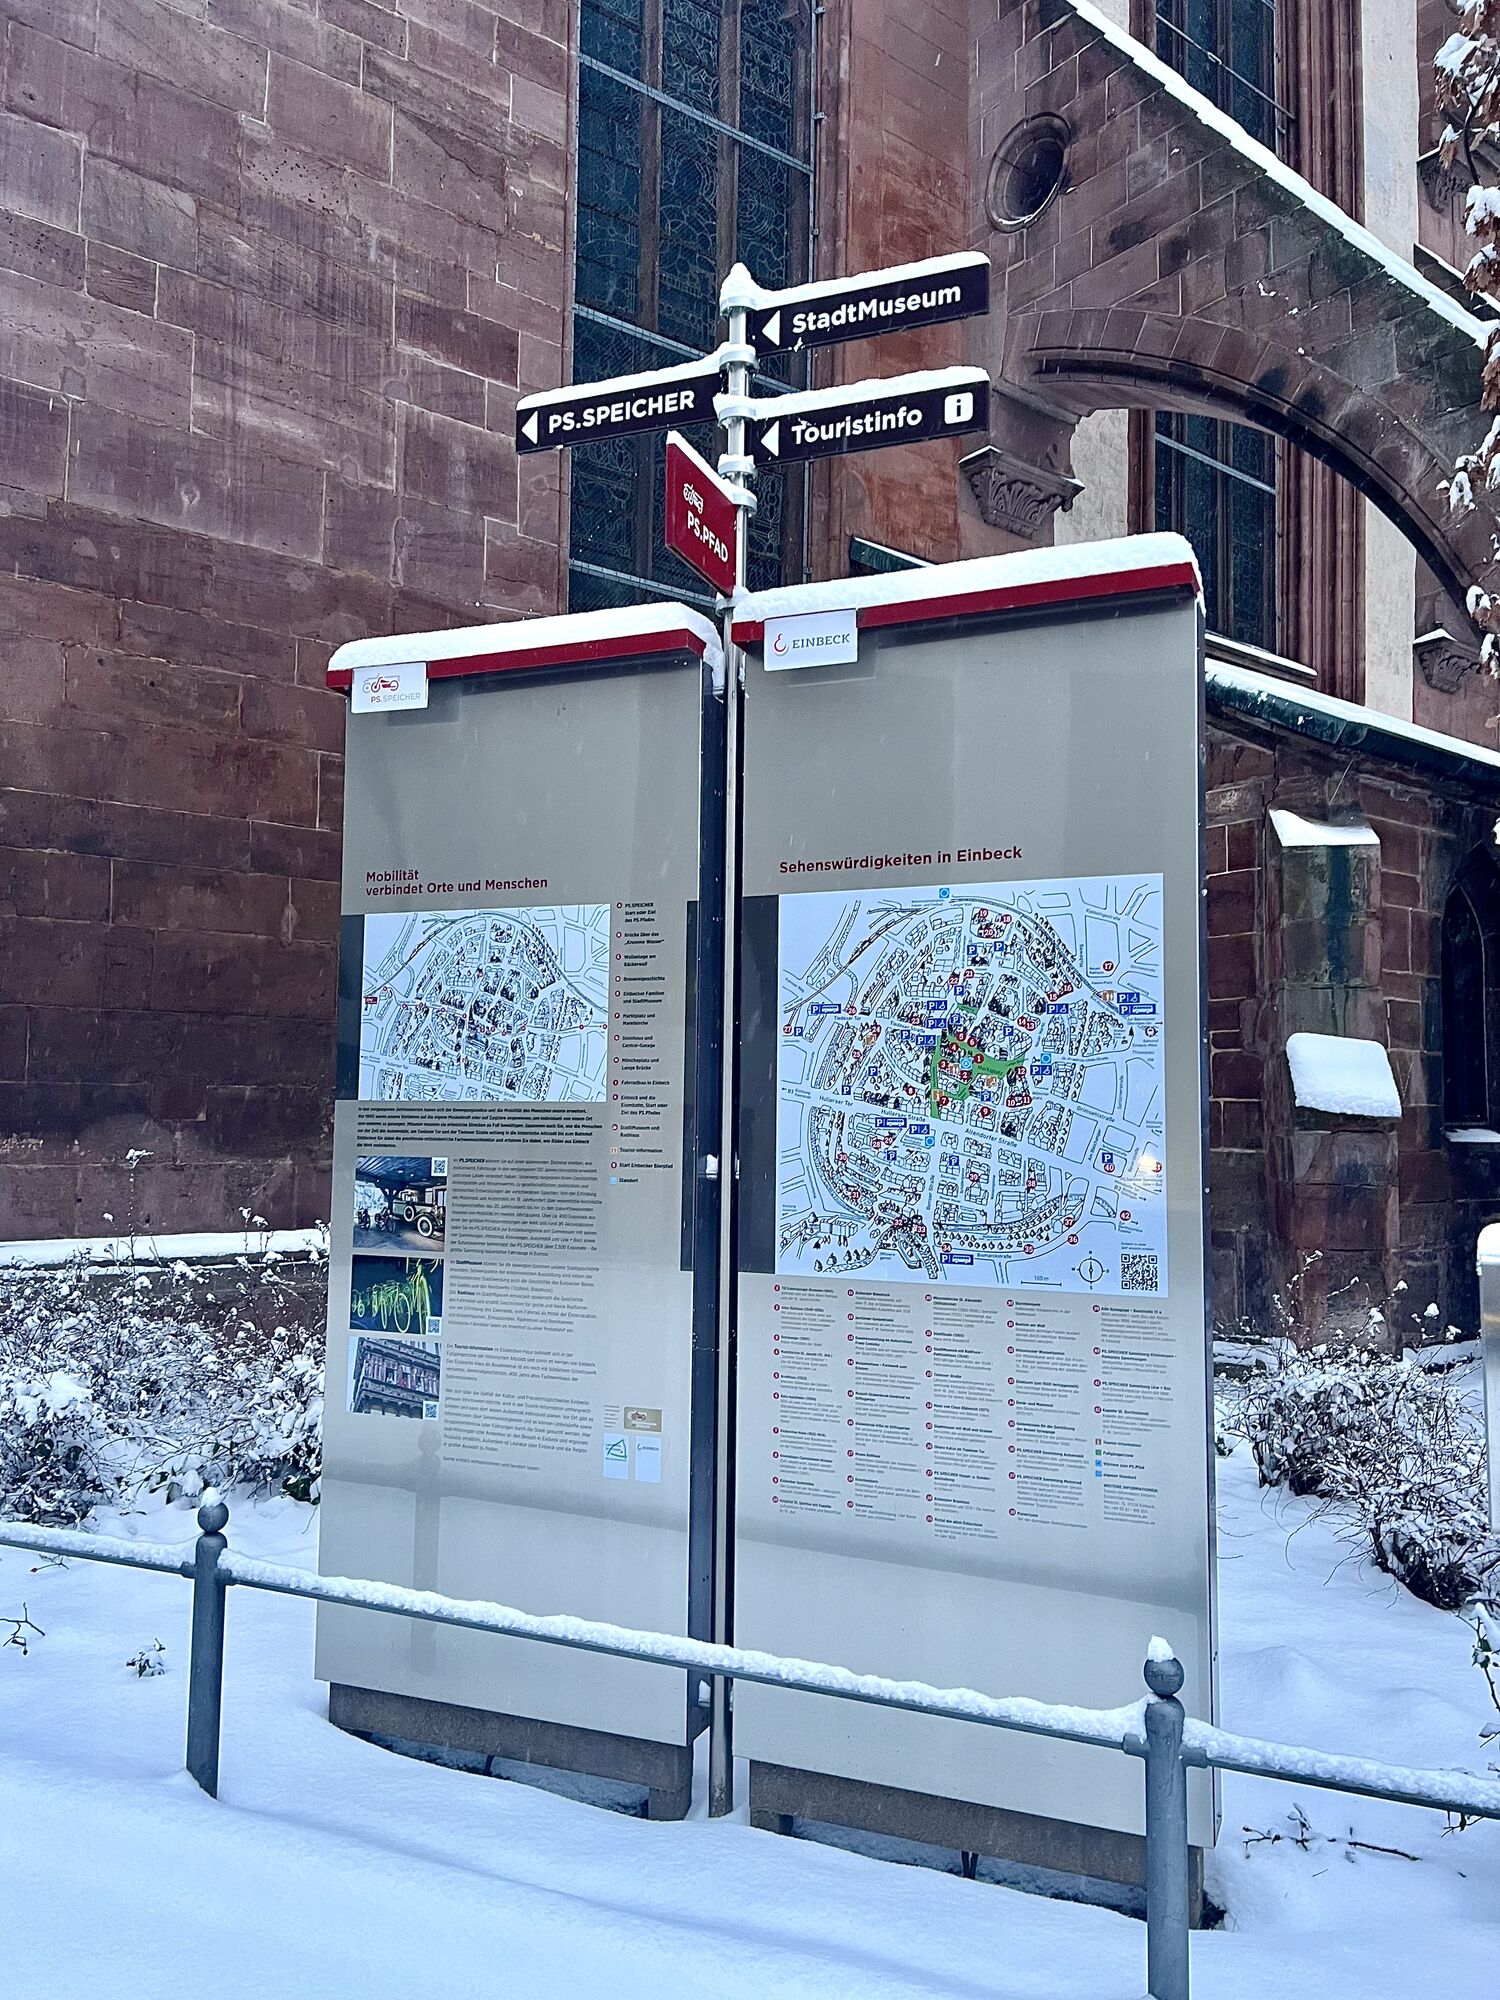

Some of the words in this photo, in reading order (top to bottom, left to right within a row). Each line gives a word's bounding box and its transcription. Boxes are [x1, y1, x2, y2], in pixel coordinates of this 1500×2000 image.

[792, 285, 962, 334] StadtMuseum
[548, 390, 696, 435] PS.SPEICHER
[791, 405, 923, 446] Touristinfo
[687, 512, 729, 563] PS.PFAD
[792, 632, 850, 650] EINBECK
[370, 691, 421, 704] PS.SPEICHER
[779, 854, 932, 874] Sehenswürdigkeiten
[937, 851, 953, 863] in
[956, 846, 1022, 862] Einbeck
[366, 869, 419, 883] Mobilität
[366, 882, 423, 896] verbindet
[427, 880, 455, 893] Orte
[458, 879, 482, 892] und
[486, 876, 548, 890] Menschen
